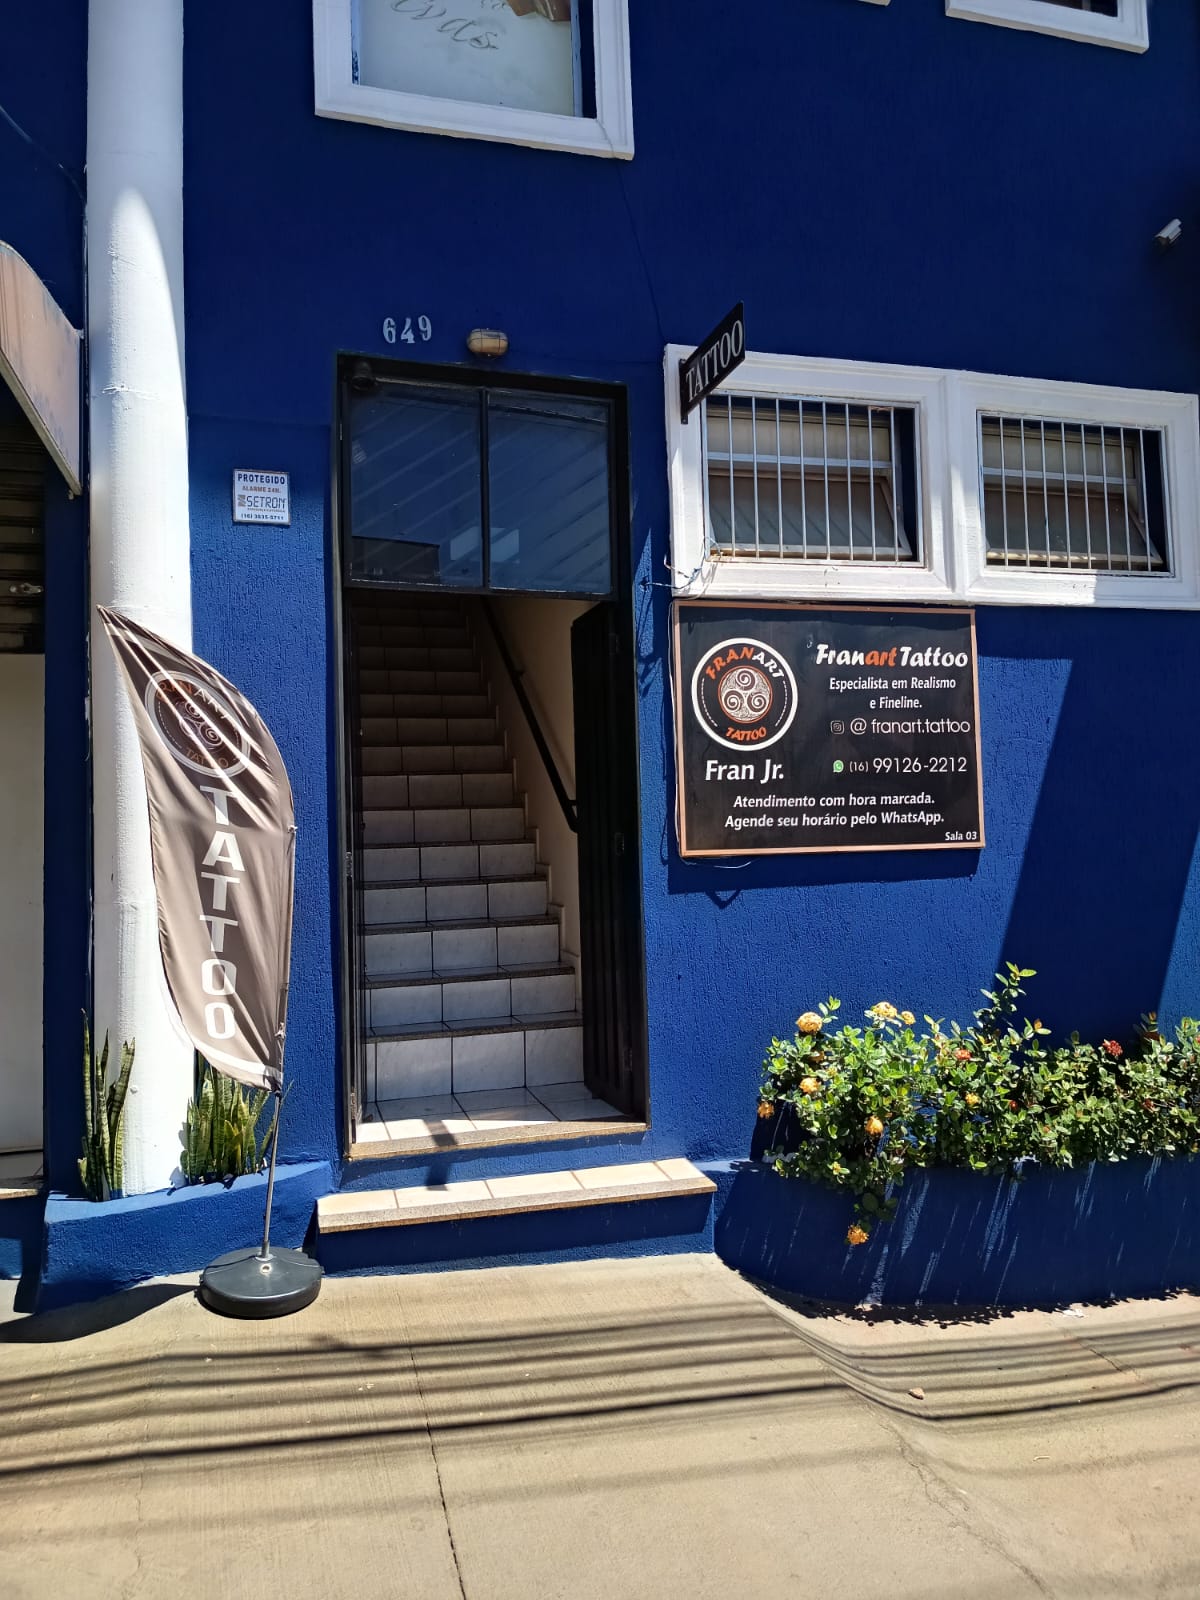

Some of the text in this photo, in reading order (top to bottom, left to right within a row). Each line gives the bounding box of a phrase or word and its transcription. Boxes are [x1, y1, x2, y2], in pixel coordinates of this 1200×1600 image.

[382, 314, 432, 344] 649
[685, 319, 743, 403] TATTOO
[238, 474, 285, 485] PROTEGIDO
[705, 646, 784, 680] FRANART
[815, 643, 969, 668] Franart Tattoo
[829, 676, 957, 693] Especialista em Realismo
[869, 696, 923, 709] e Fineline.
[725, 726, 768, 741] TATTOO
[705, 758, 785, 785] Fran Jr.
[849, 756, 968, 774] (16) 99126-2212
[733, 792, 935, 808] Atendimento com hora marcada.
[724, 811, 945, 831] Agende seu horário pelo WhatsApp.
[945, 831, 977, 841] Sala 03
[199, 786, 246, 1040] TATTOO
